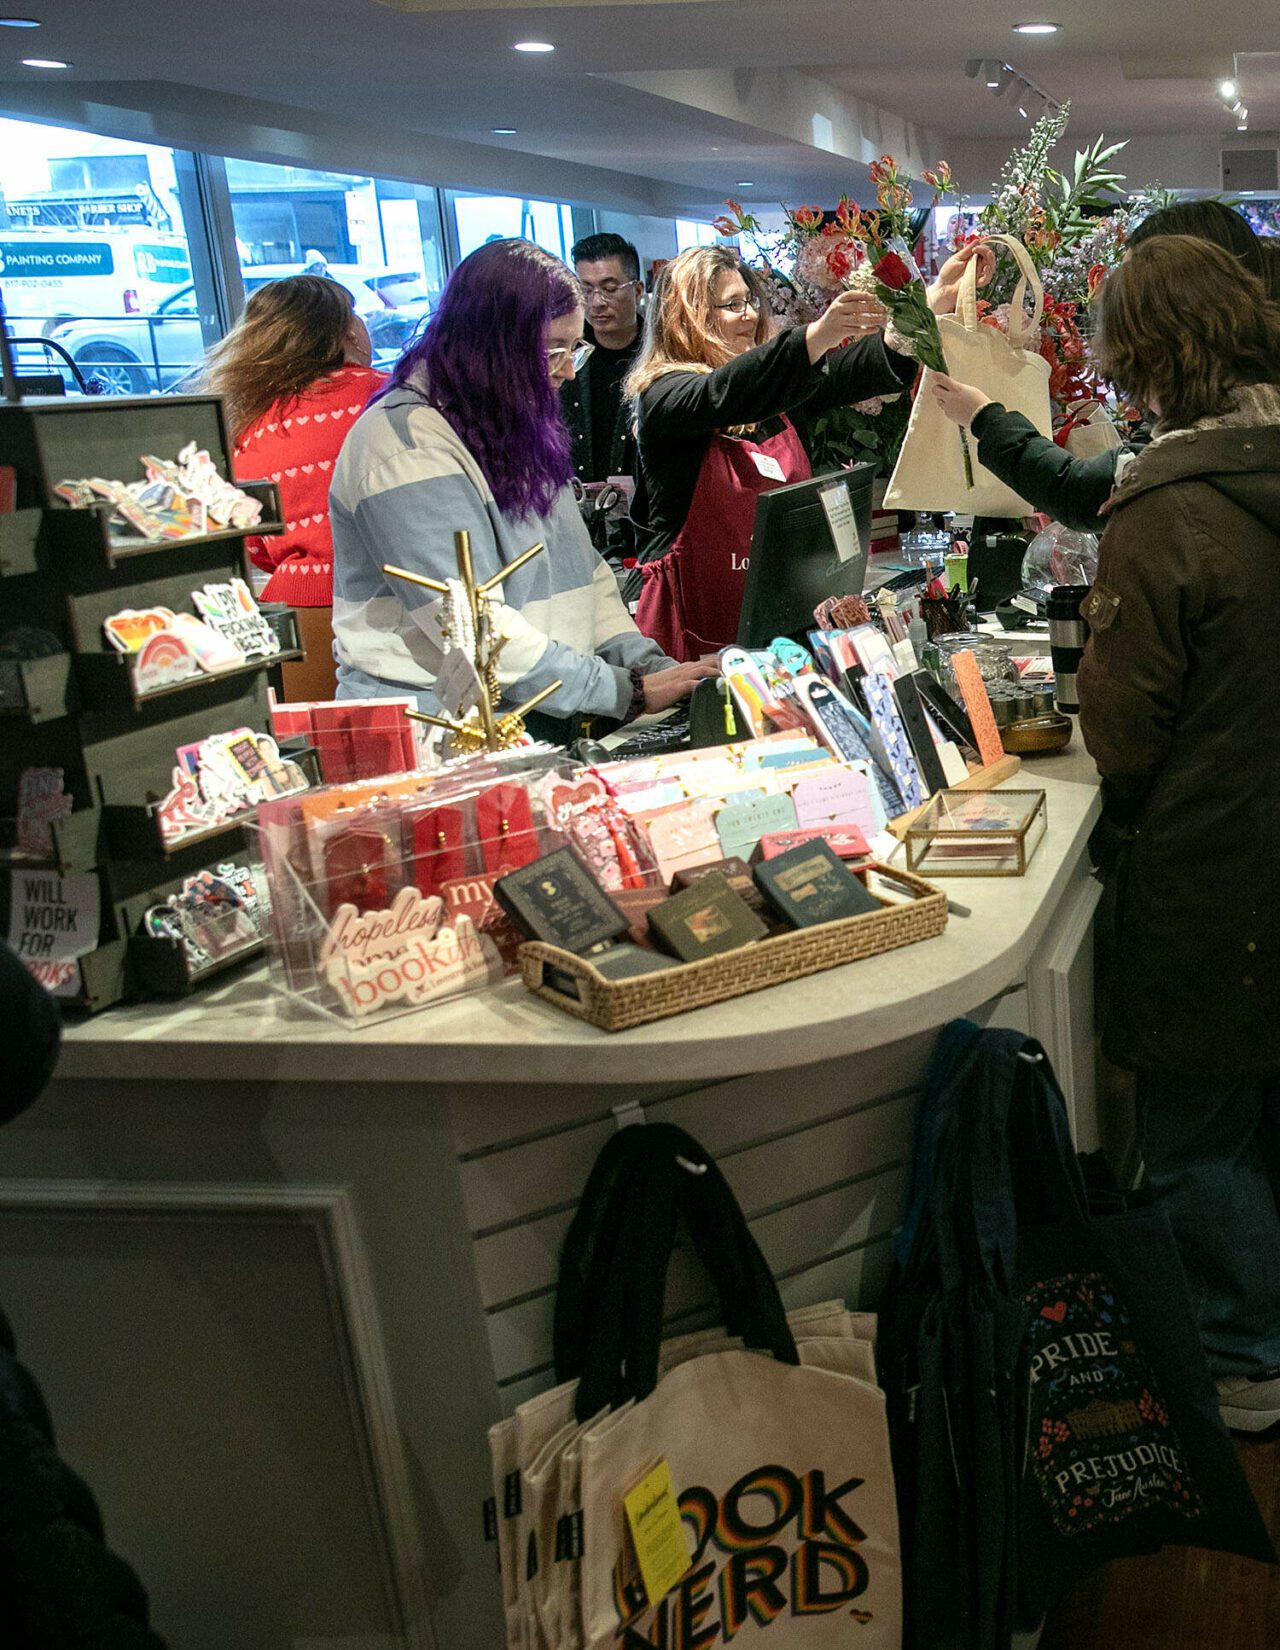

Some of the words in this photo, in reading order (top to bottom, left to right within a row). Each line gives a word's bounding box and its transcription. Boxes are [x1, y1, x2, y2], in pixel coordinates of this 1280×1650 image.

[79, 203, 116, 214] BARBER
[118, 202, 143, 213] SHOP
[6, 255, 54, 266] PAINTING
[55, 254, 102, 265] COMPANY
[234, 632, 268, 651] BEST
[24, 879, 66, 904] WILL
[451, 877, 496, 906] my
[24, 906, 79, 932] WORK
[330, 897, 442, 955] hopeless
[21, 932, 55, 956] FOR
[339, 922, 481, 1007] bookish
[1030, 1332, 1118, 1385] PRIDE
[1069, 1370, 1104, 1386] AND
[1055, 1442, 1183, 1494] PREJUDICE
[1102, 1479, 1132, 1508] Jane
[1132, 1471, 1168, 1502] Austen
[618, 1540, 870, 1650] NERD
